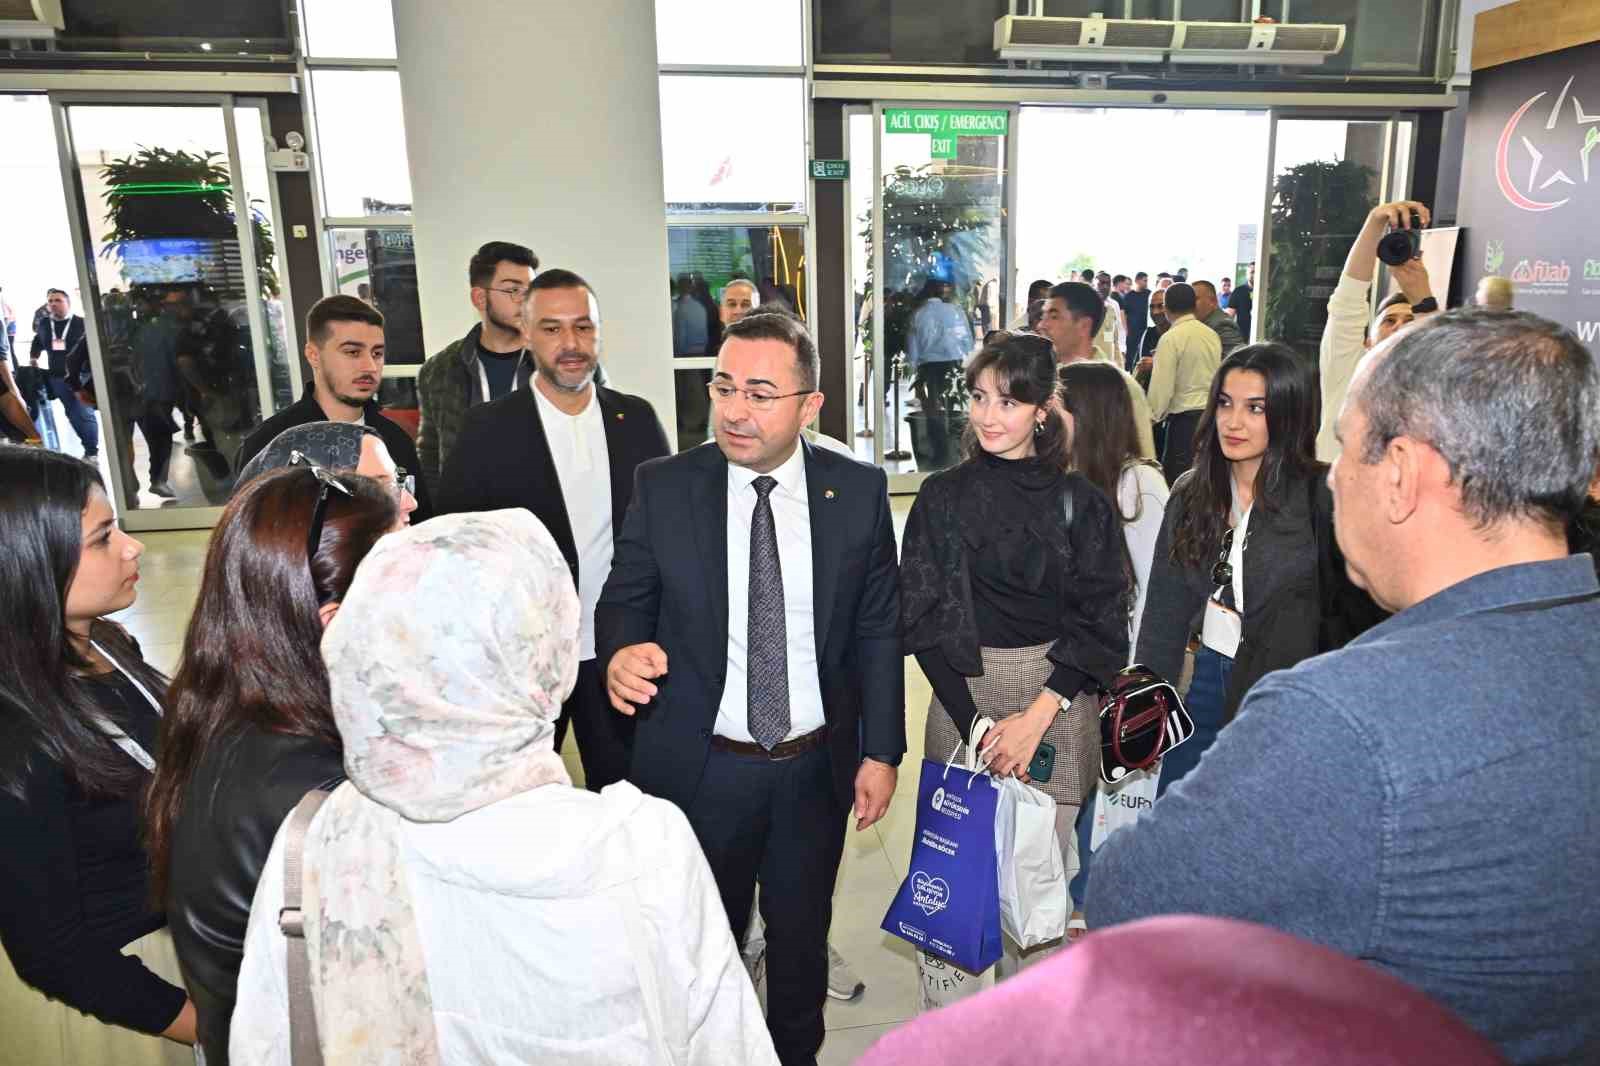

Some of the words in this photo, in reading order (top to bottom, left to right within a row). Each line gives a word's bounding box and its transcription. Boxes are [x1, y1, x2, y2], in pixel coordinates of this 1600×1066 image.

[890, 111, 912, 129] ACİL
[914, 113, 940, 132] ÇIKIŞ
[949, 113, 1006, 130] EMERGENCY
[932, 139, 952, 153] EXIT
